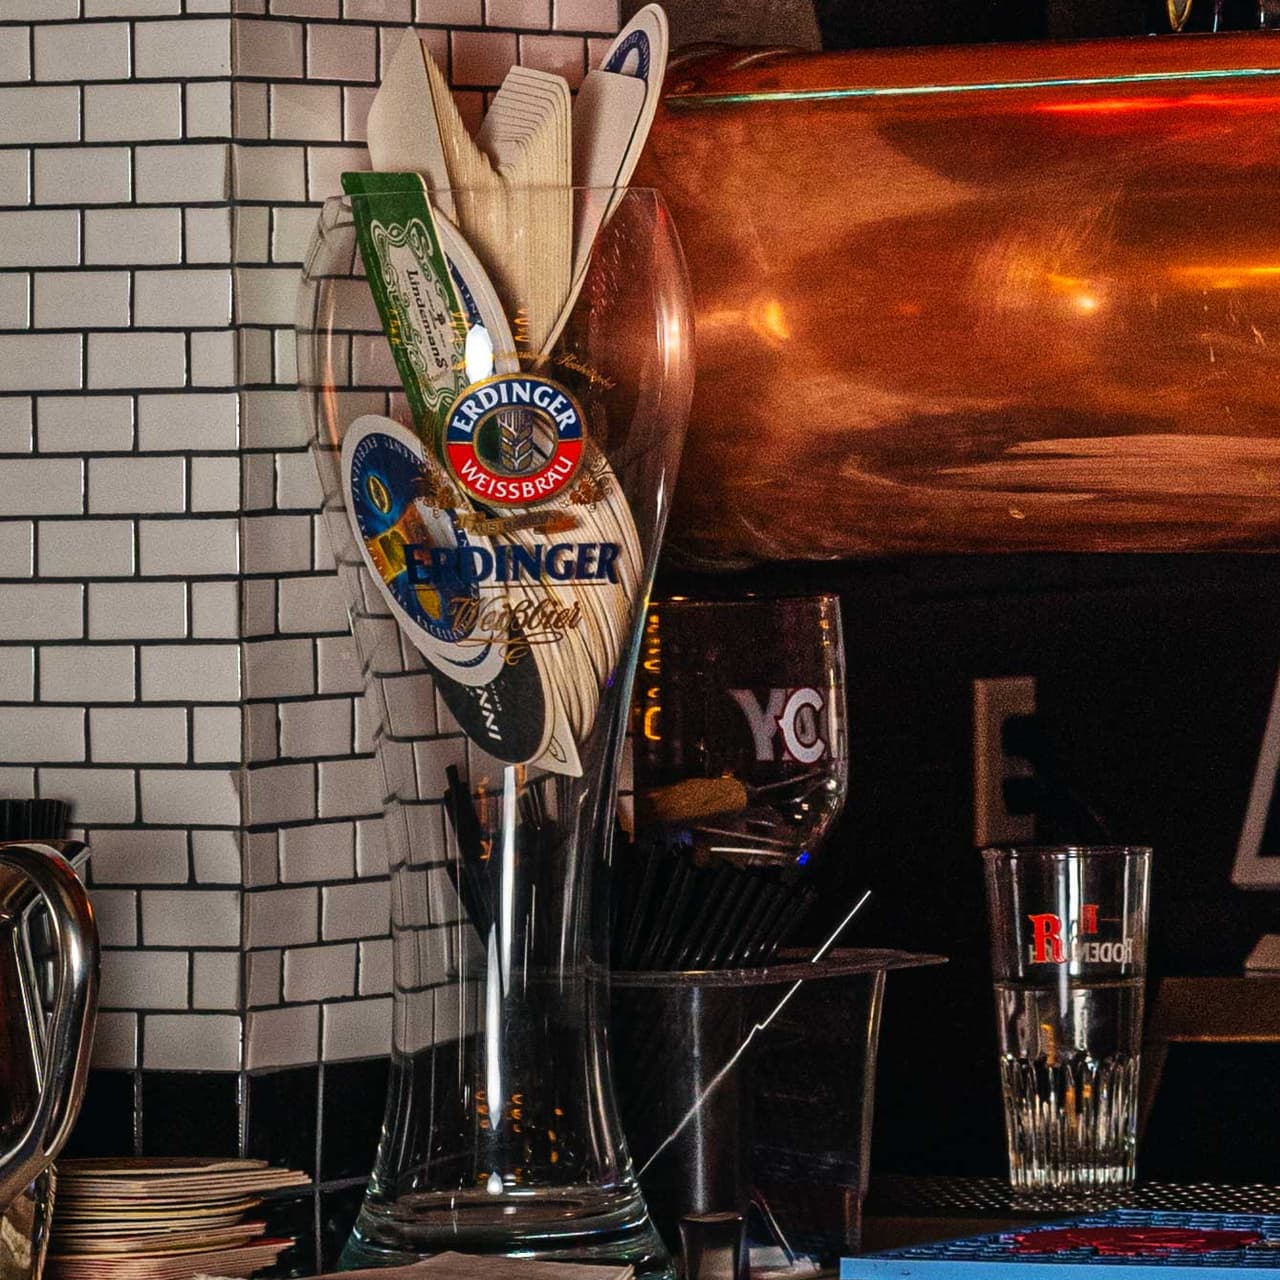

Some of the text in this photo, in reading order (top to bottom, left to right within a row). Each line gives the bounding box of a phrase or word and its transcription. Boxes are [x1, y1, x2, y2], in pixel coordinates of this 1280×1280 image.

[406, 268, 449, 370] Lindemans
[451, 381, 578, 433] ERDINGER
[460, 456, 574, 500] WEISSBRÄU
[402, 542, 621, 586] ERDINGER
